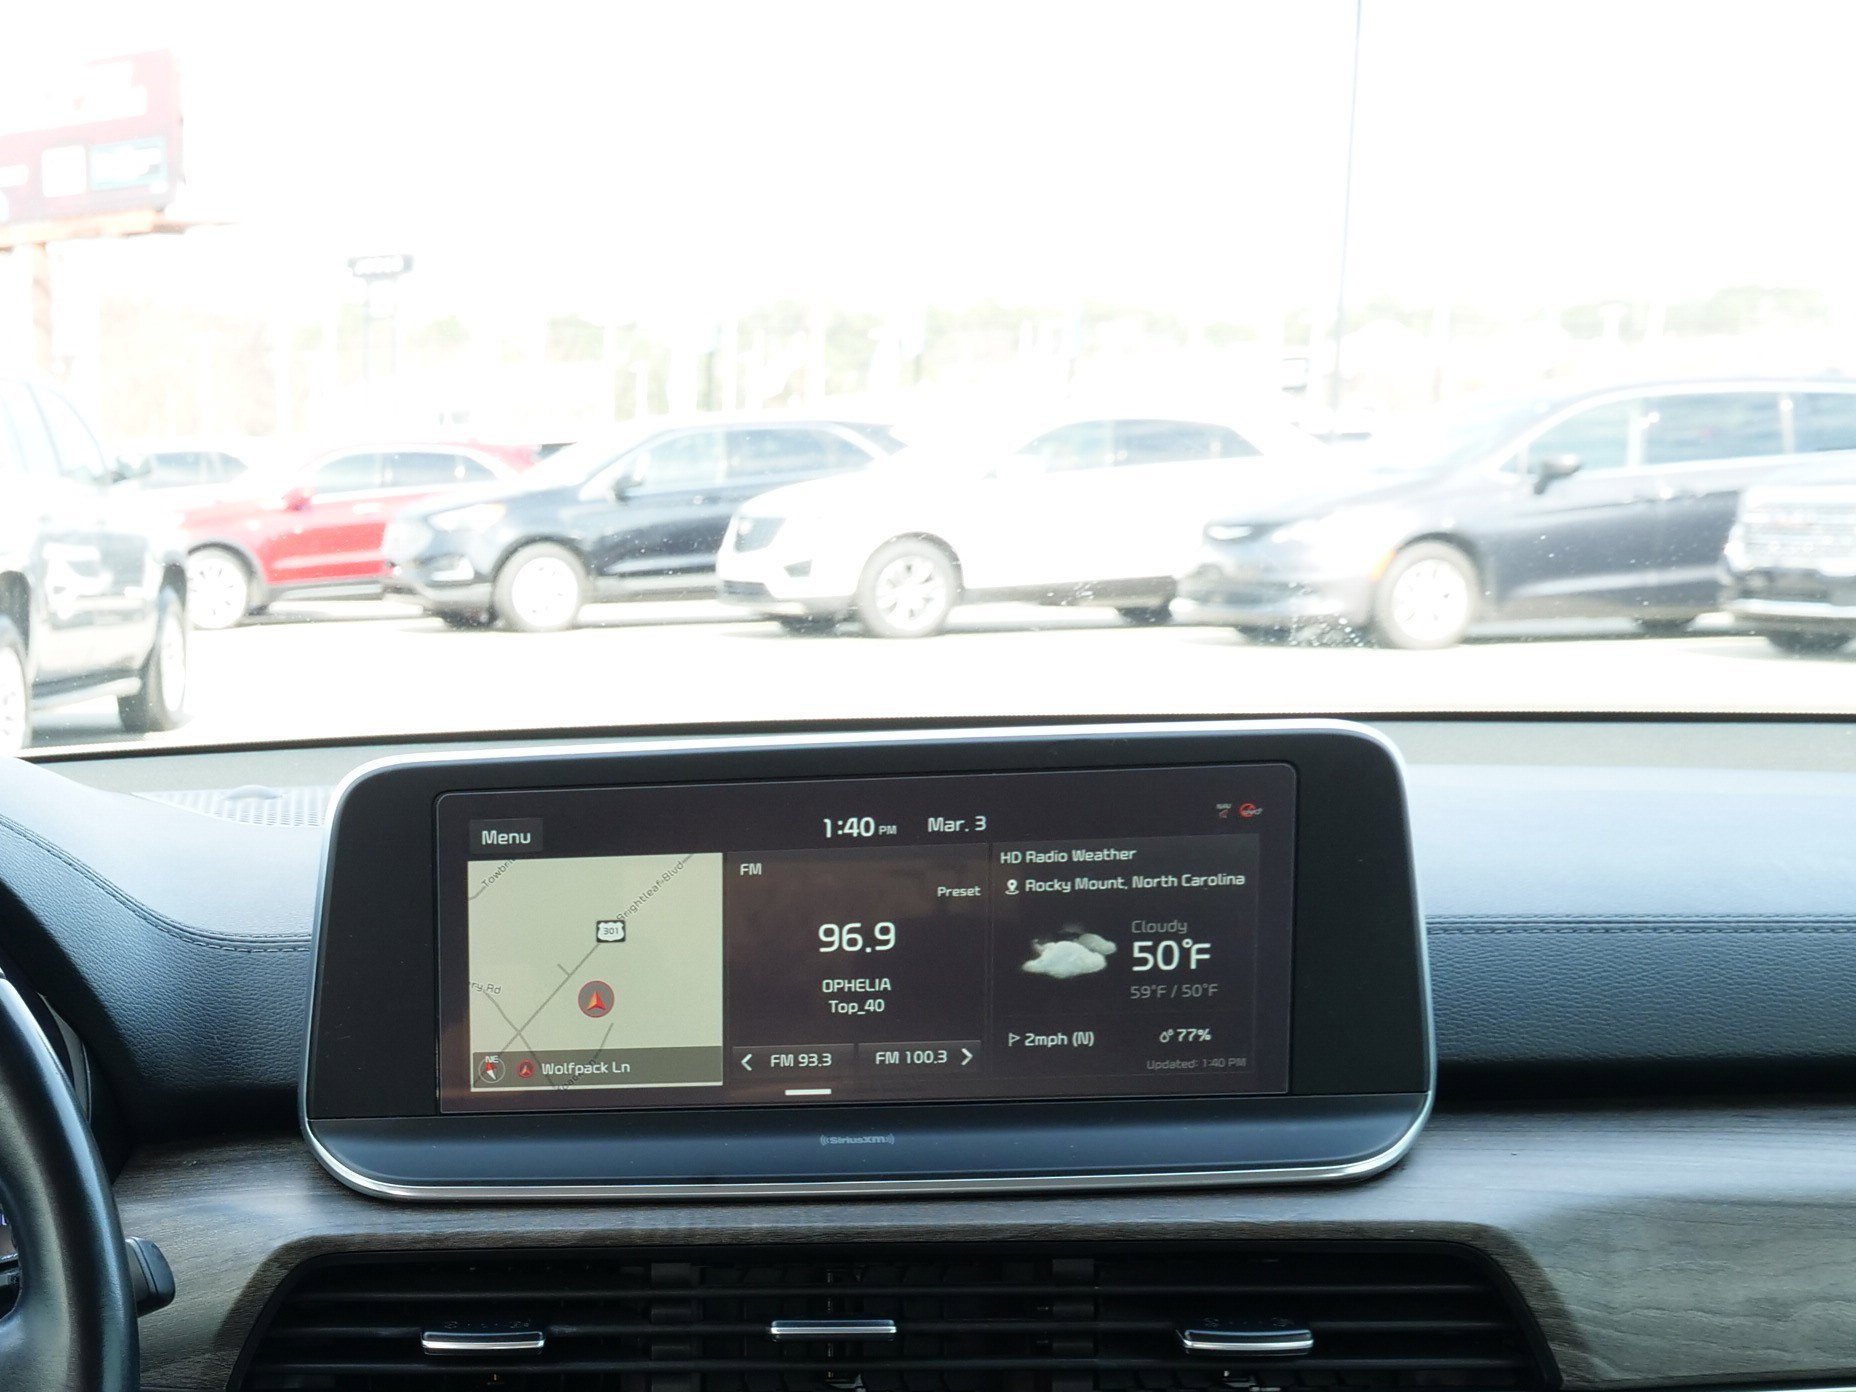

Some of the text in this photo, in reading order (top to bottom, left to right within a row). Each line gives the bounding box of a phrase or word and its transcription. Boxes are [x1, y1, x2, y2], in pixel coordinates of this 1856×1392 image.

[823, 817, 897, 839] 1:40 PM
[927, 816, 987, 833] Mar. 3
[481, 829, 532, 846] Menu
[1000, 847, 1137, 865] HD Radio Weather
[740, 863, 762, 876] FM
[937, 884, 981, 898] Preset
[1025, 872, 1246, 896] Rocky Mount, North Carolina
[602, 927, 620, 936] 301
[1131, 919, 1188, 937] Cloudy
[817, 921, 897, 954] 96.9
[1131, 938, 1212, 972] 50°F
[822, 977, 892, 994] OPHELIA
[1130, 983, 1166, 999] 59°F
[1182, 982, 1219, 998] 50°F
[829, 998, 885, 1016] Top_40
[1024, 1030, 1095, 1049] 2mph (N)
[1177, 1028, 1212, 1043] 77%
[485, 1055, 499, 1064] NE
[770, 1052, 832, 1067] FM 93.3
[875, 1050, 948, 1065] FM 100.3
[541, 1061, 609, 1076] Wolfpack
[612, 1060, 631, 1074] Ln
